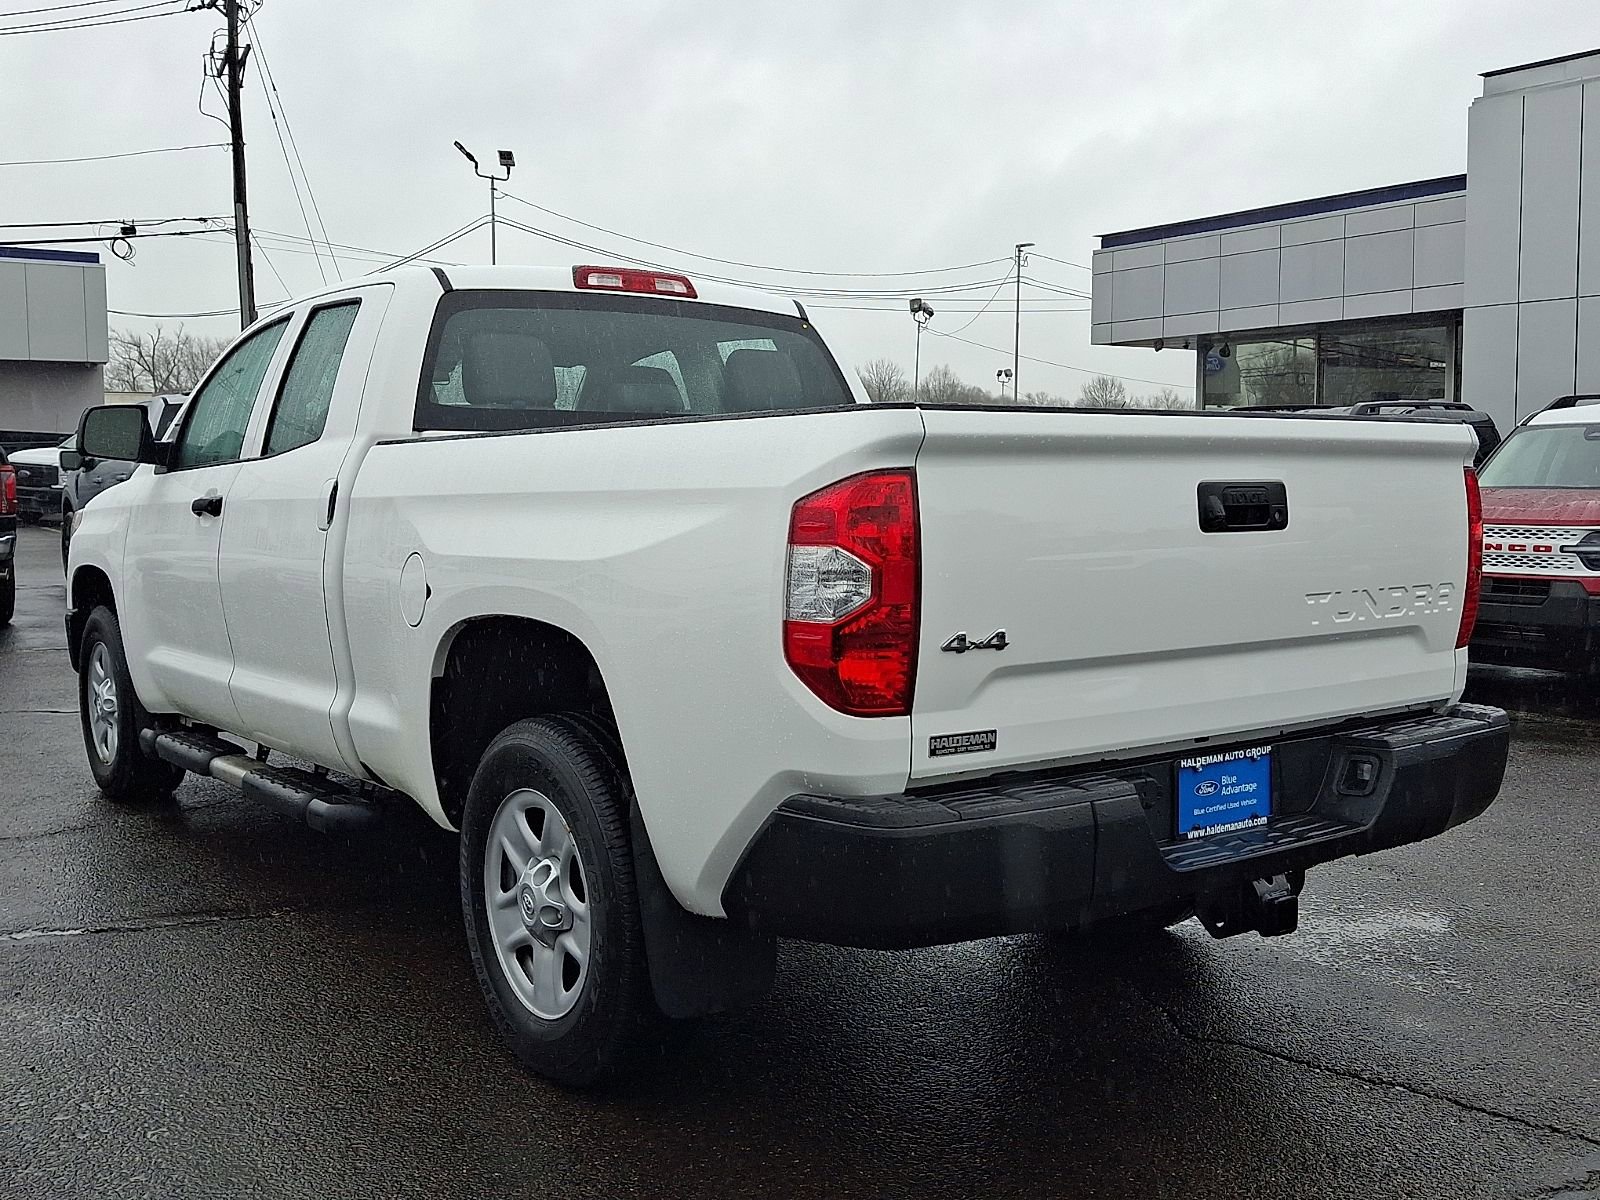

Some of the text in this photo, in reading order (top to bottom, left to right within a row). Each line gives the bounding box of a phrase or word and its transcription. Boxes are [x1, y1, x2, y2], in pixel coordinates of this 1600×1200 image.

[1305, 582, 1455, 625] TUNDRA
[930, 732, 996, 749] HALDEMAN
[1181, 745, 1272, 768] HALDEMAN AUTO GROUP
[1221, 775, 1237, 785] Blue
[1221, 782, 1257, 796] Advantage
[1193, 798, 1257, 816] Blue Certified Used Vehicle
[1187, 816, 1268, 839] www.haldemanauto.com
